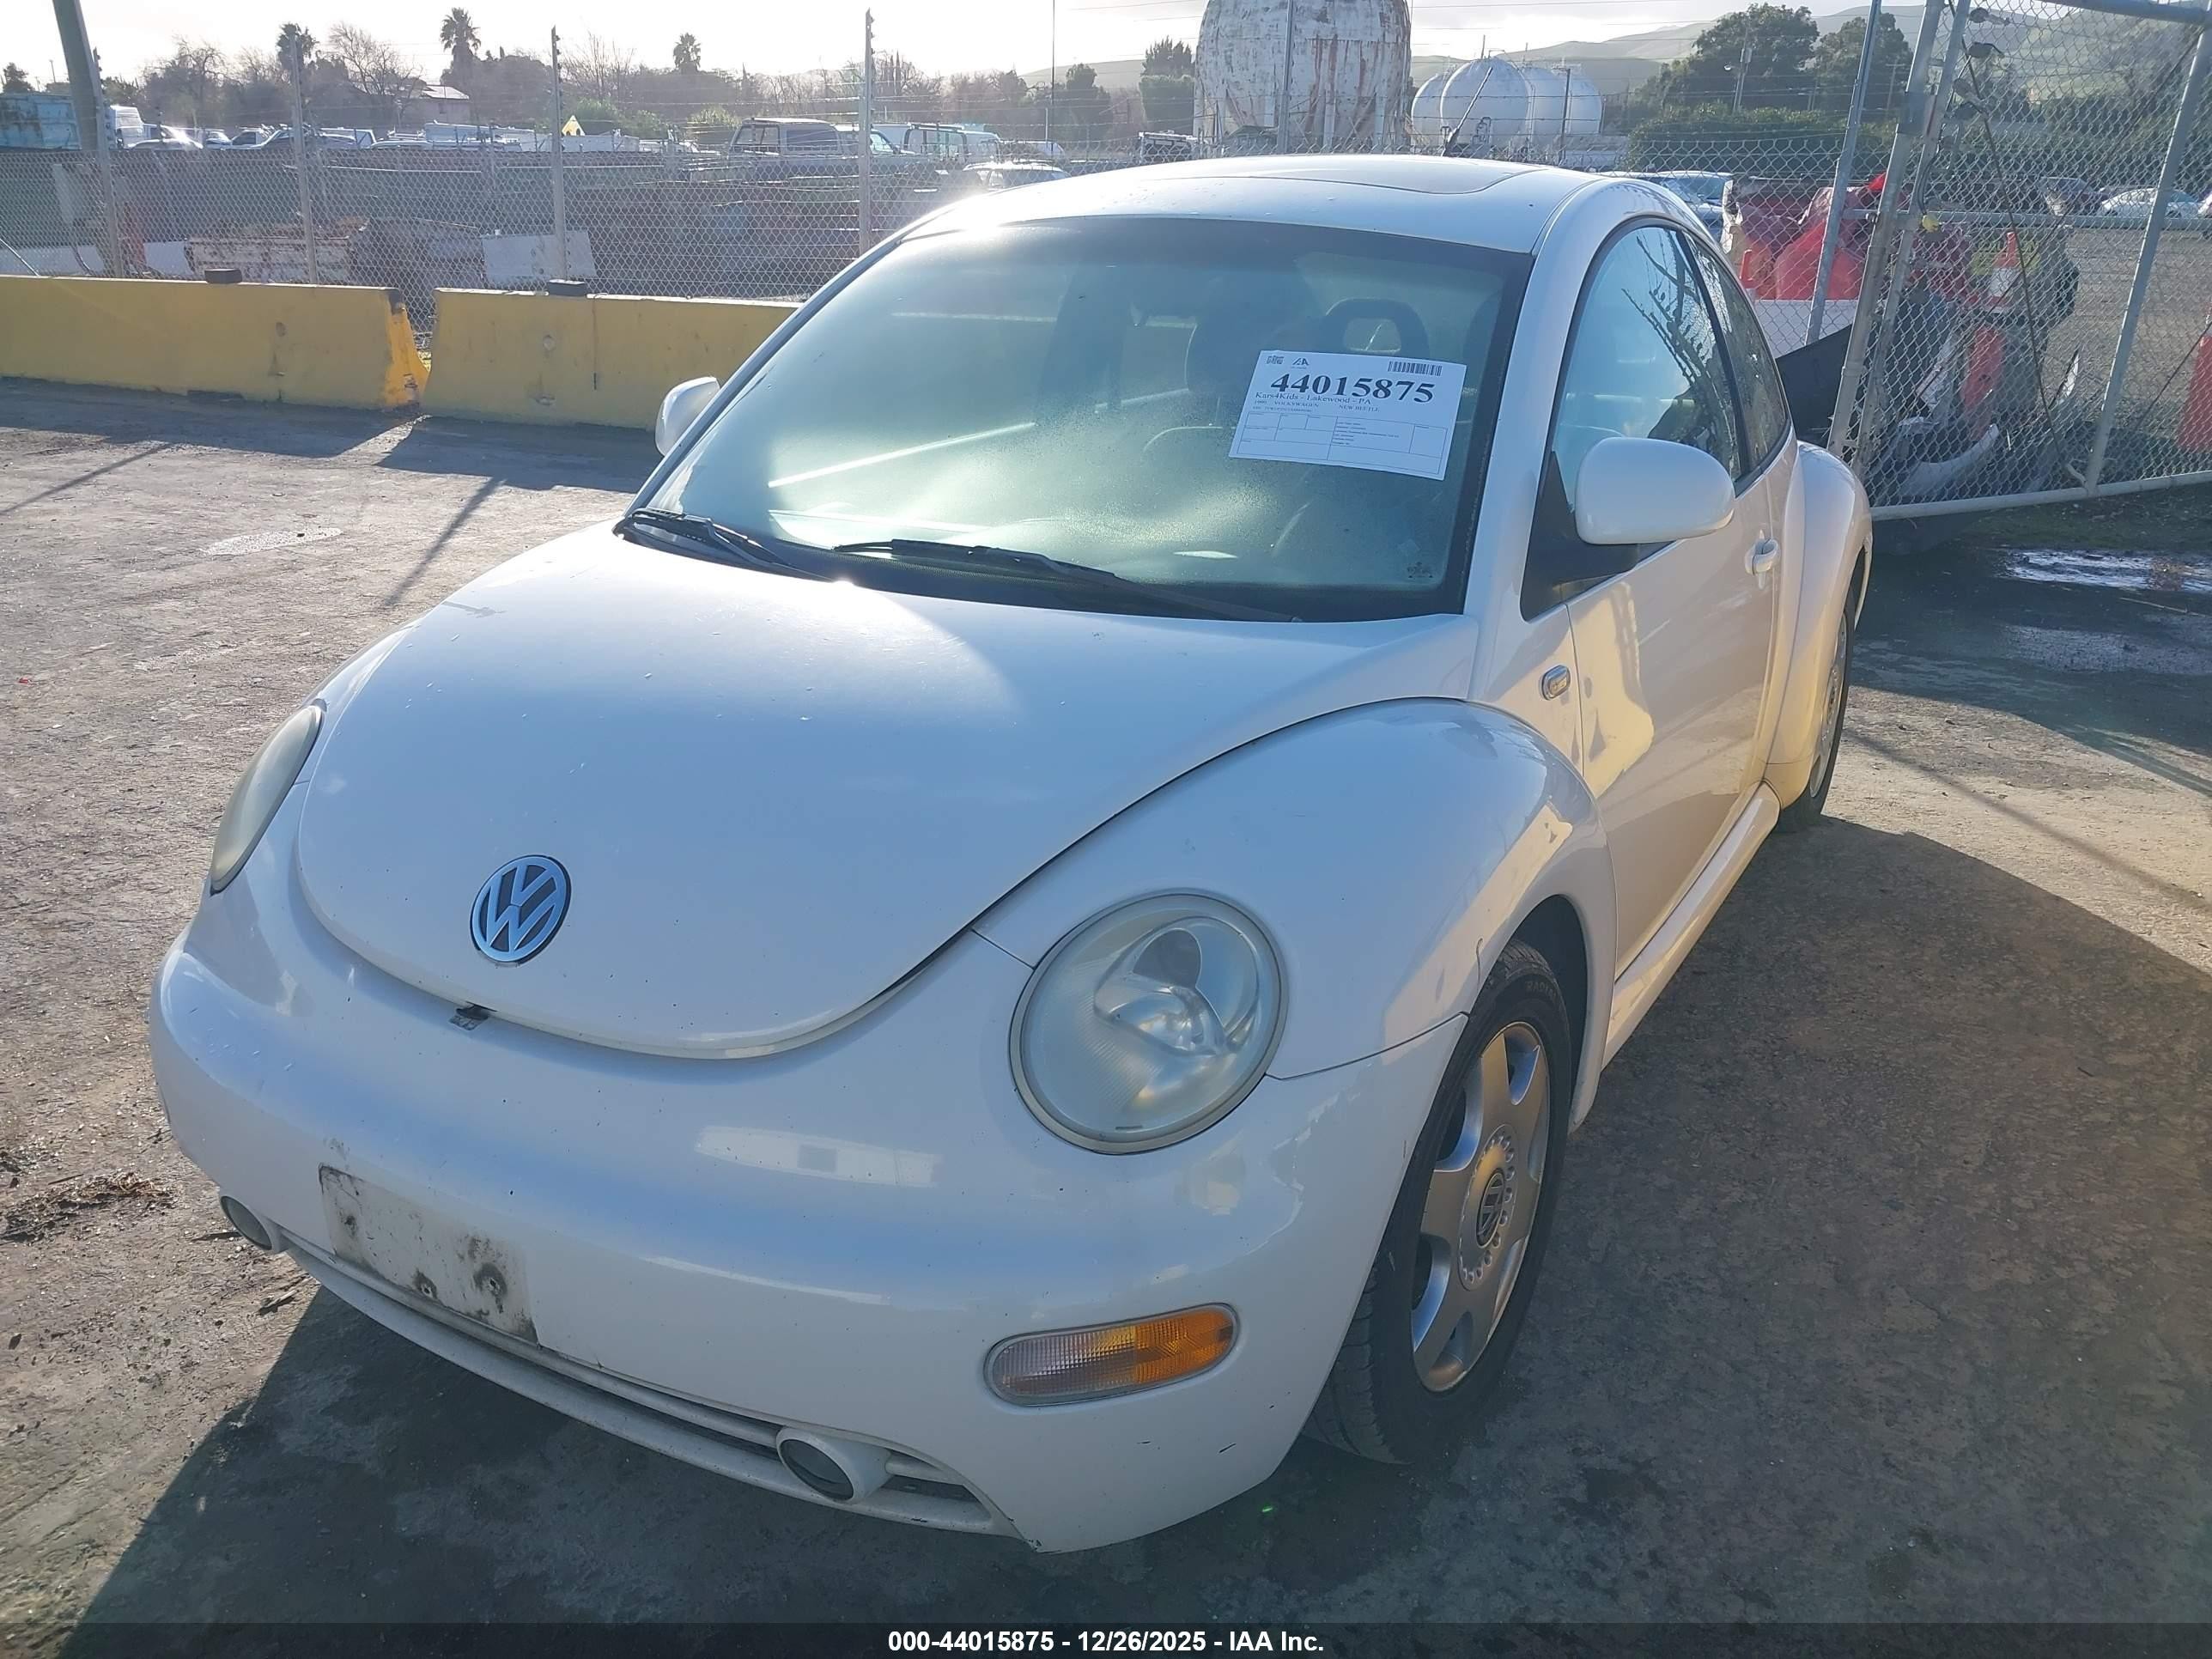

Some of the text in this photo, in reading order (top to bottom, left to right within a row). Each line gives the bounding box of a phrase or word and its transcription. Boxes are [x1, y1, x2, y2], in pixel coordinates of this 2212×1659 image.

[1255, 392, 1298, 401] Kars4Kids
[1306, 393, 1350, 404] Lakewood
[1271, 374, 1436, 403] 44015875
